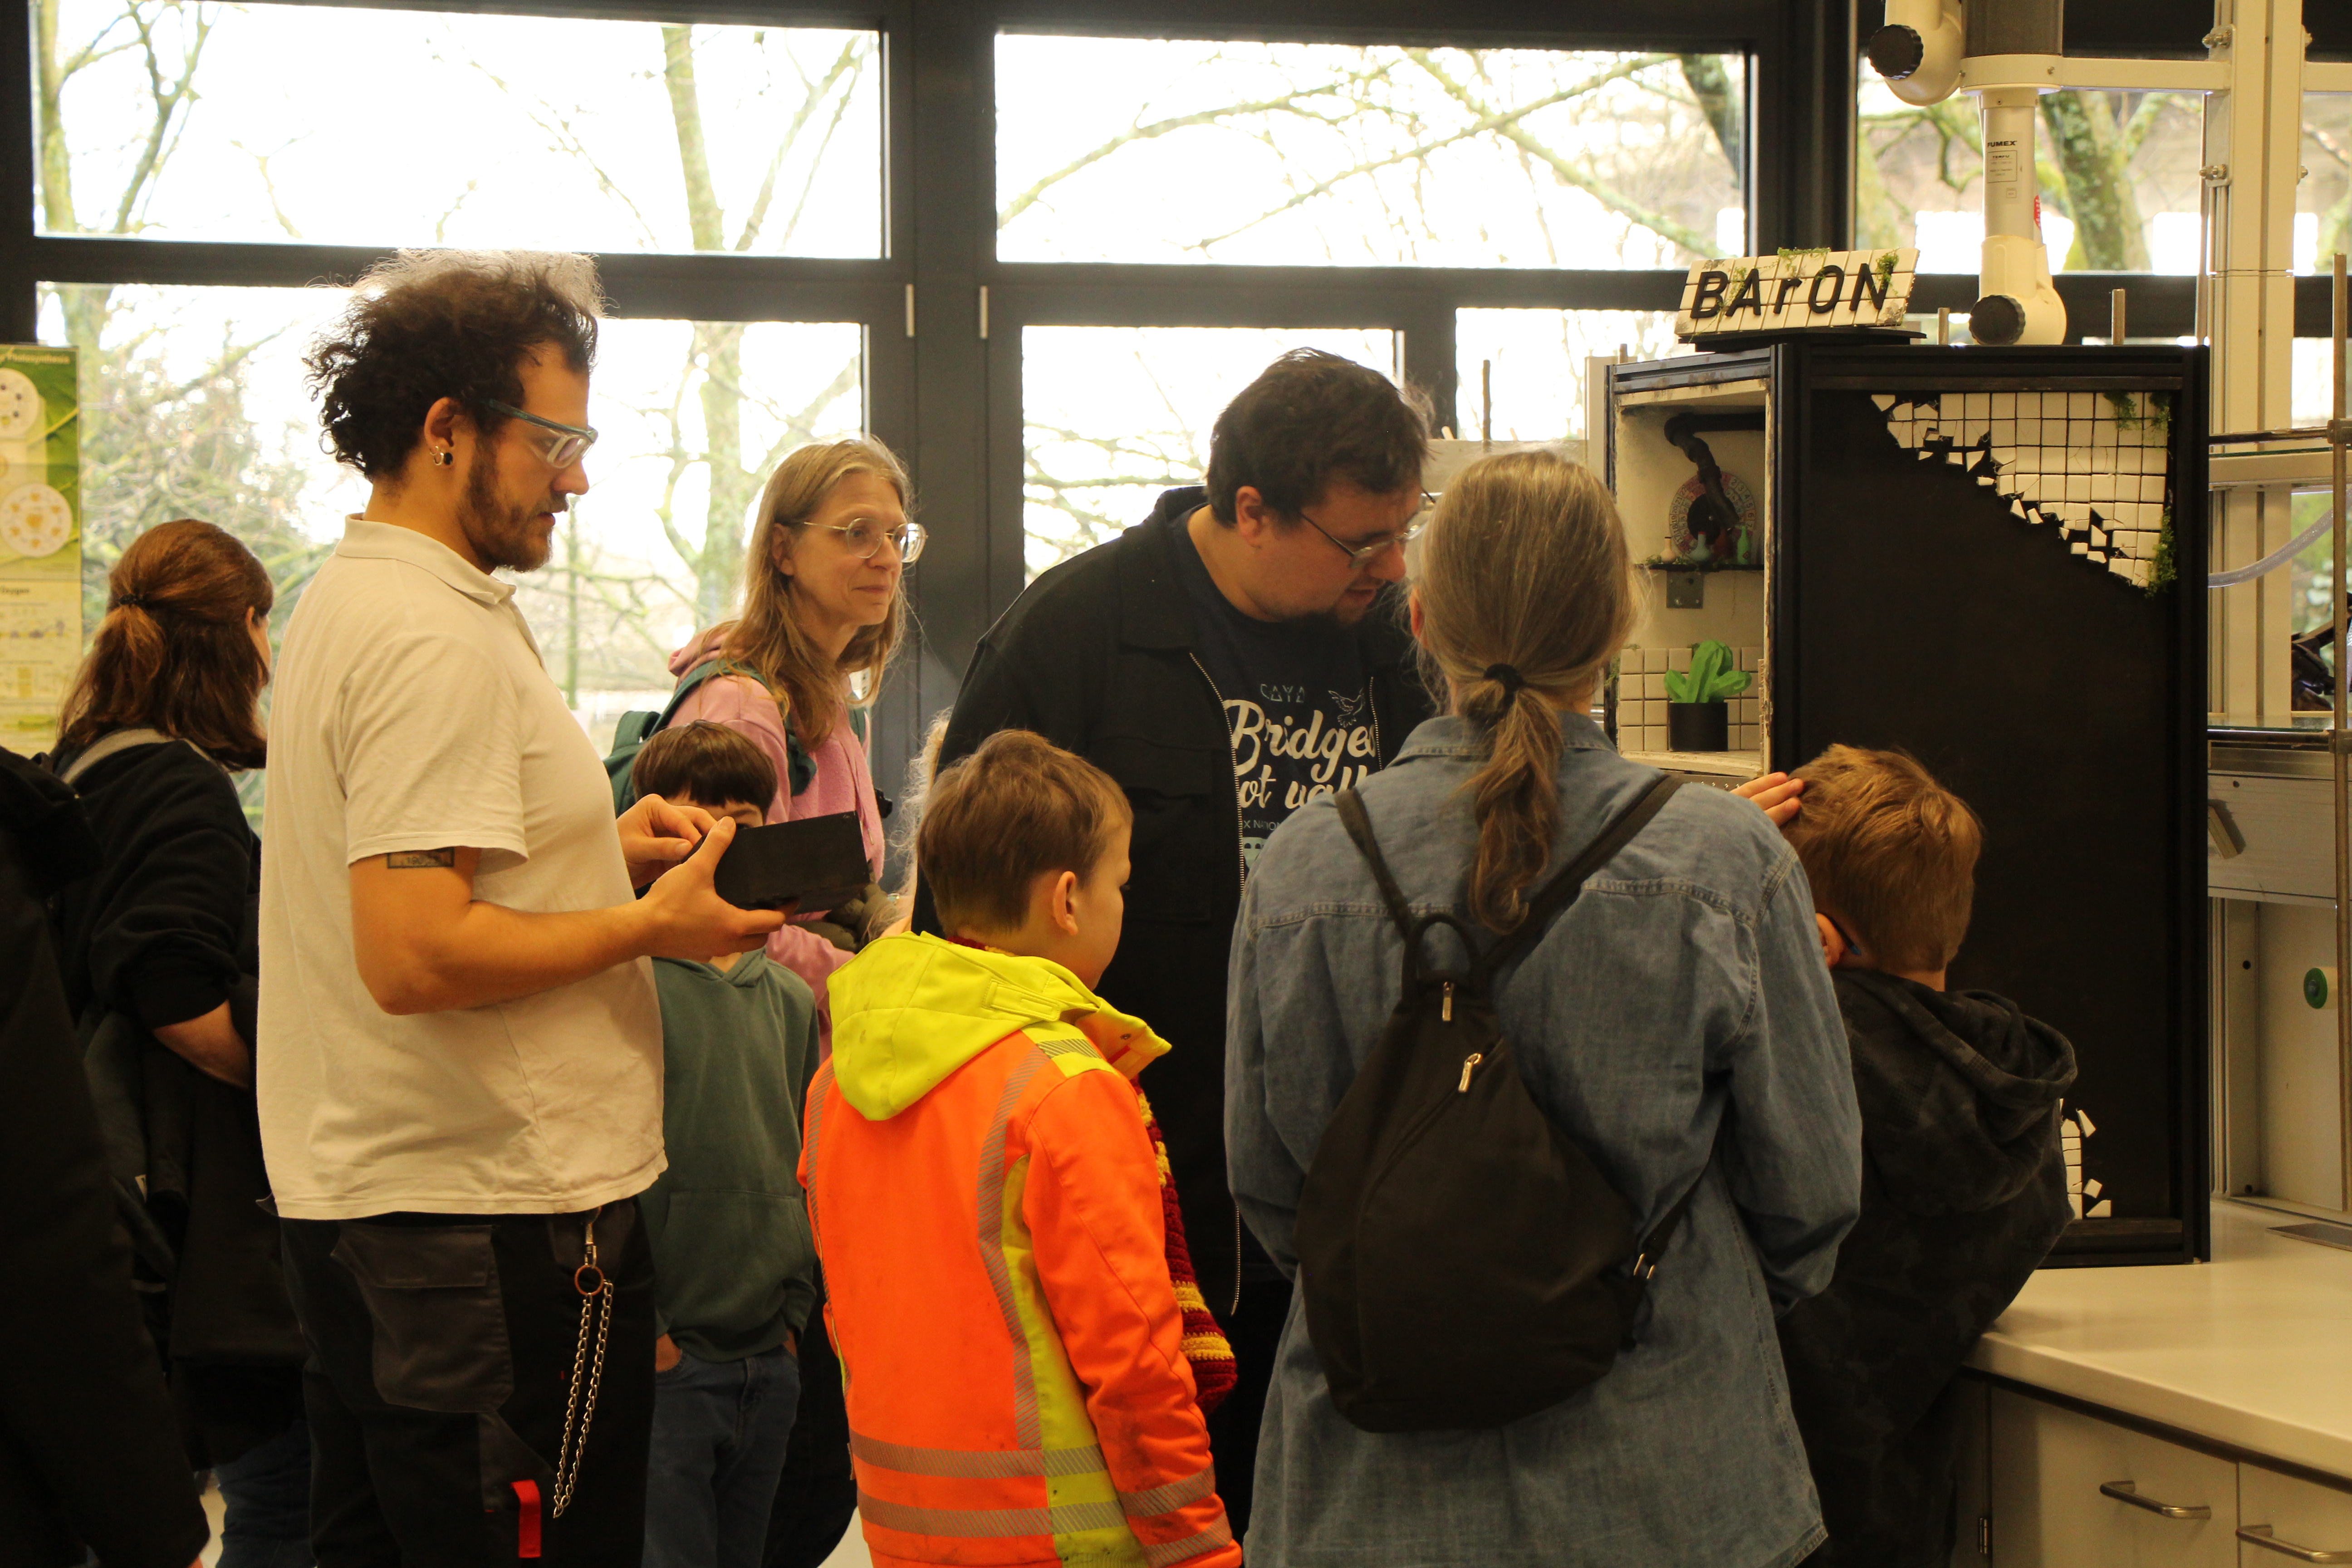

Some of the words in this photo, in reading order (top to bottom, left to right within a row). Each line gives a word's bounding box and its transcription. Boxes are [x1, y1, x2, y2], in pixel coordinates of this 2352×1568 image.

[1680, 487, 1686, 495] 22
[1672, 524, 1680, 534] 18
[1239, 764, 1276, 809] ot
